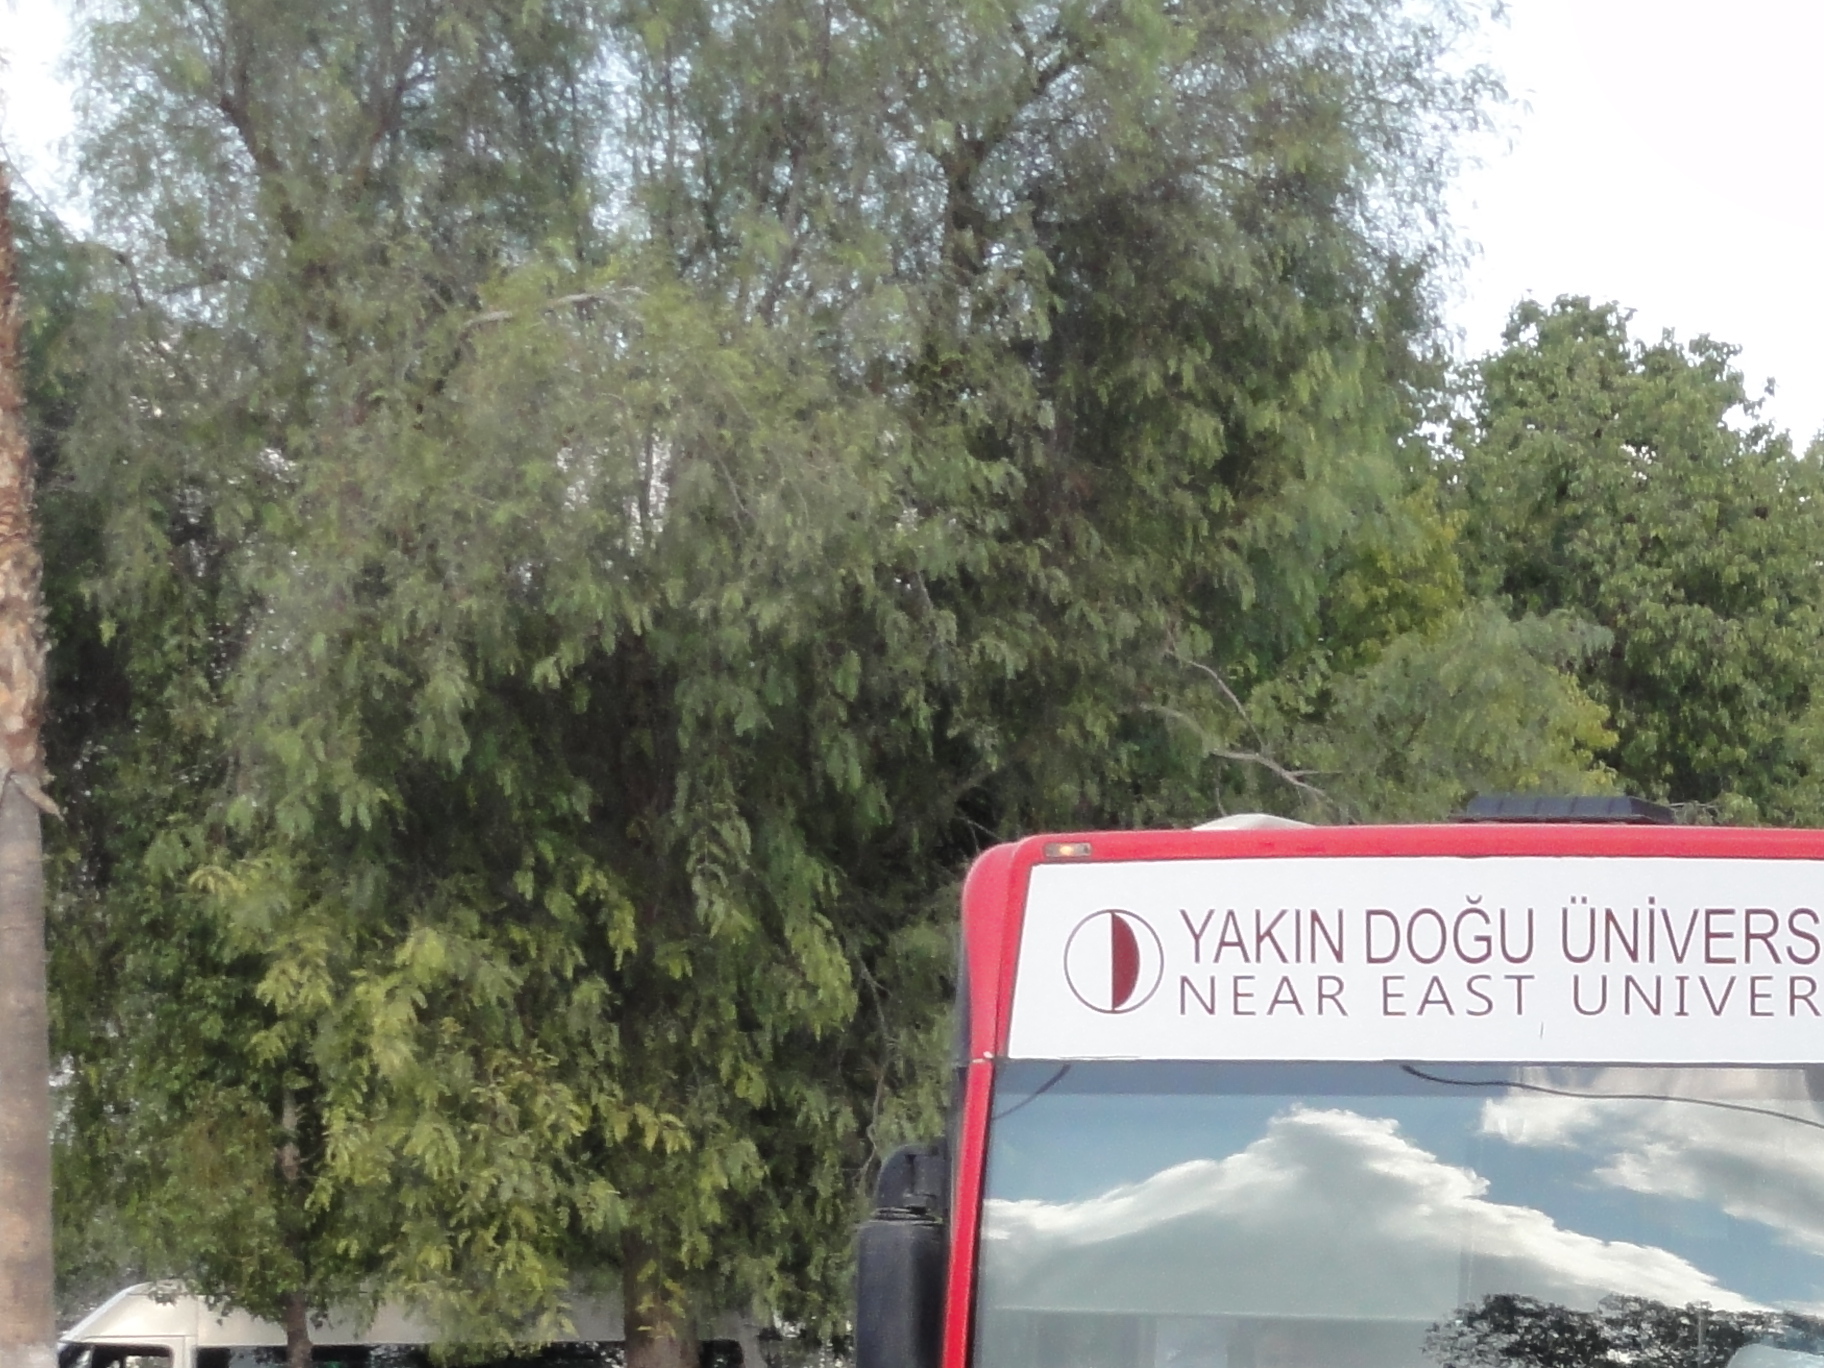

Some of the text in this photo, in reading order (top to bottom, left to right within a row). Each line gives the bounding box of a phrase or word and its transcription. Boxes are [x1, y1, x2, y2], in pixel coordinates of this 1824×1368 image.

[1179, 908, 1344, 965] YAKIN
[1365, 896, 1535, 966] DOĞU
[1179, 974, 1349, 1017] NEAR
[1382, 974, 1536, 1017] EAST
